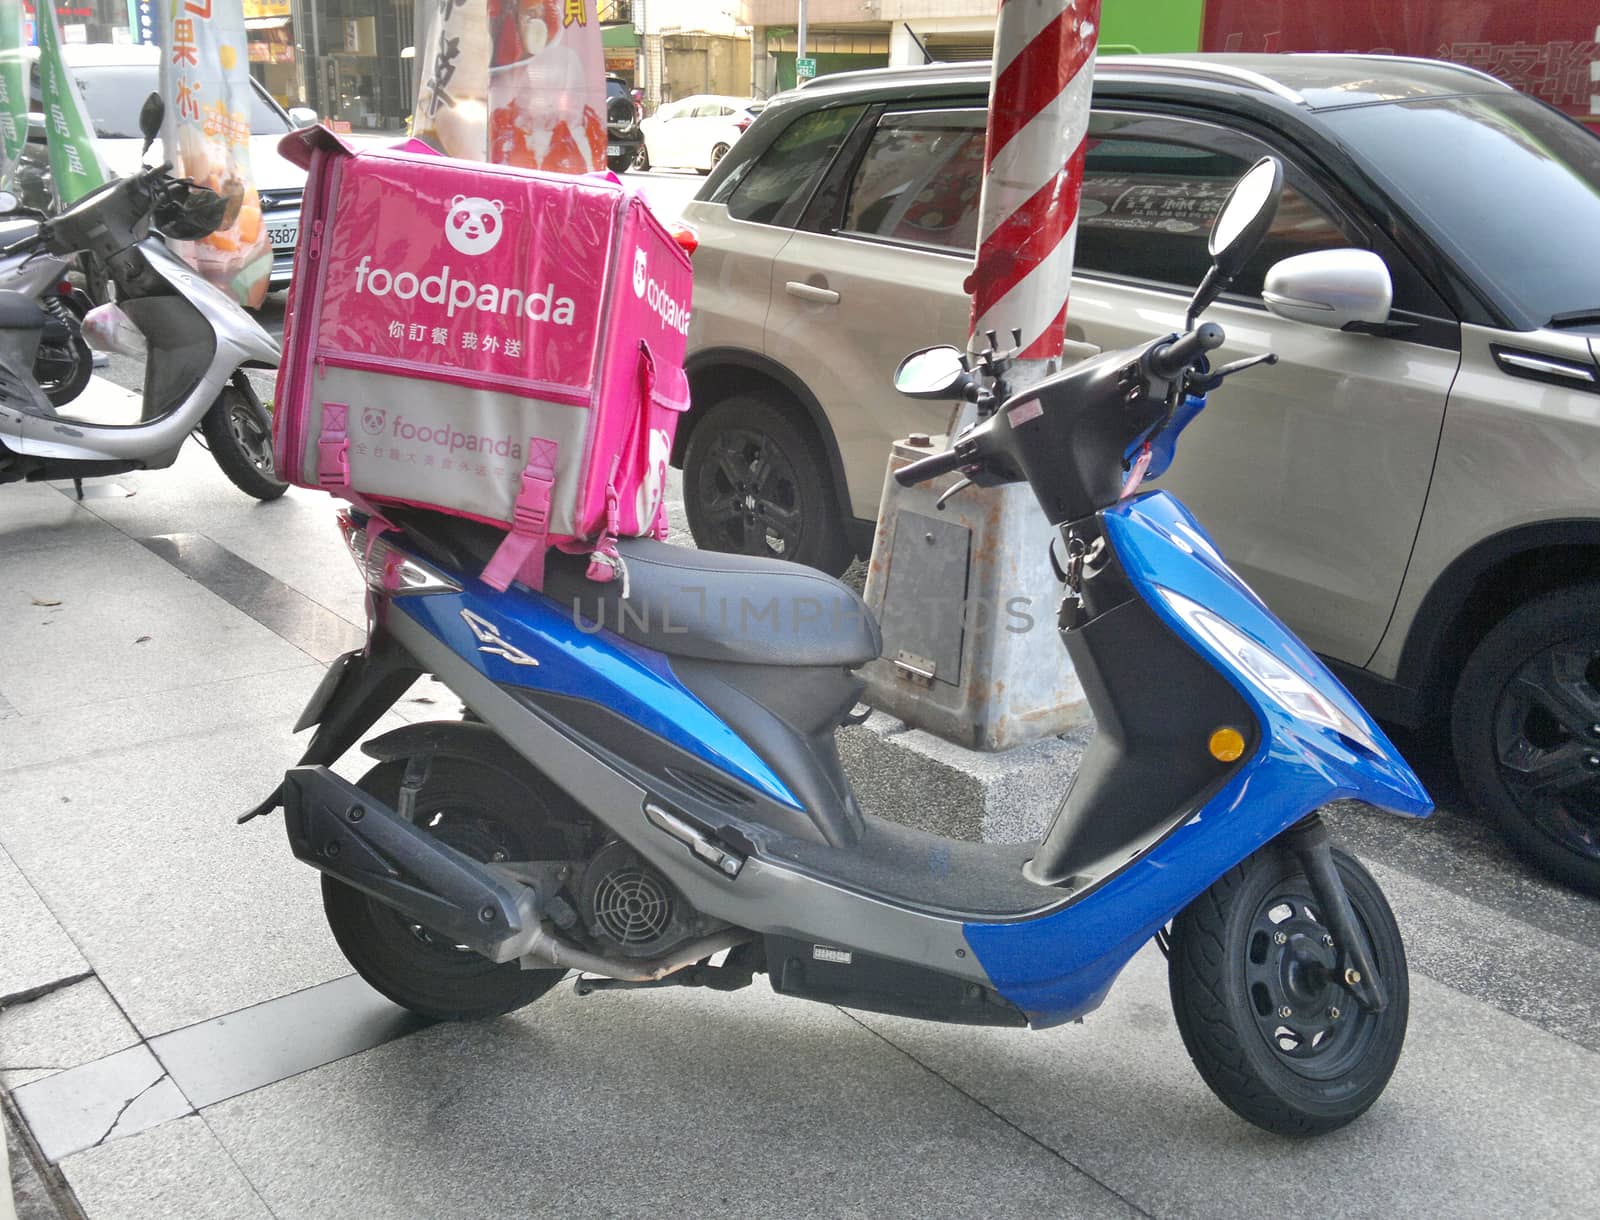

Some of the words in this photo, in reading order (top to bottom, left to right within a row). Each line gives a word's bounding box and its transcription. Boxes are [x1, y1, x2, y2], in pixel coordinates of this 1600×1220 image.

[354, 256, 576, 326] foodpanda
[388, 320, 449, 346] 你訂餐
[461, 331, 521, 358] 我外送
[391, 415, 522, 459] foodpanda
